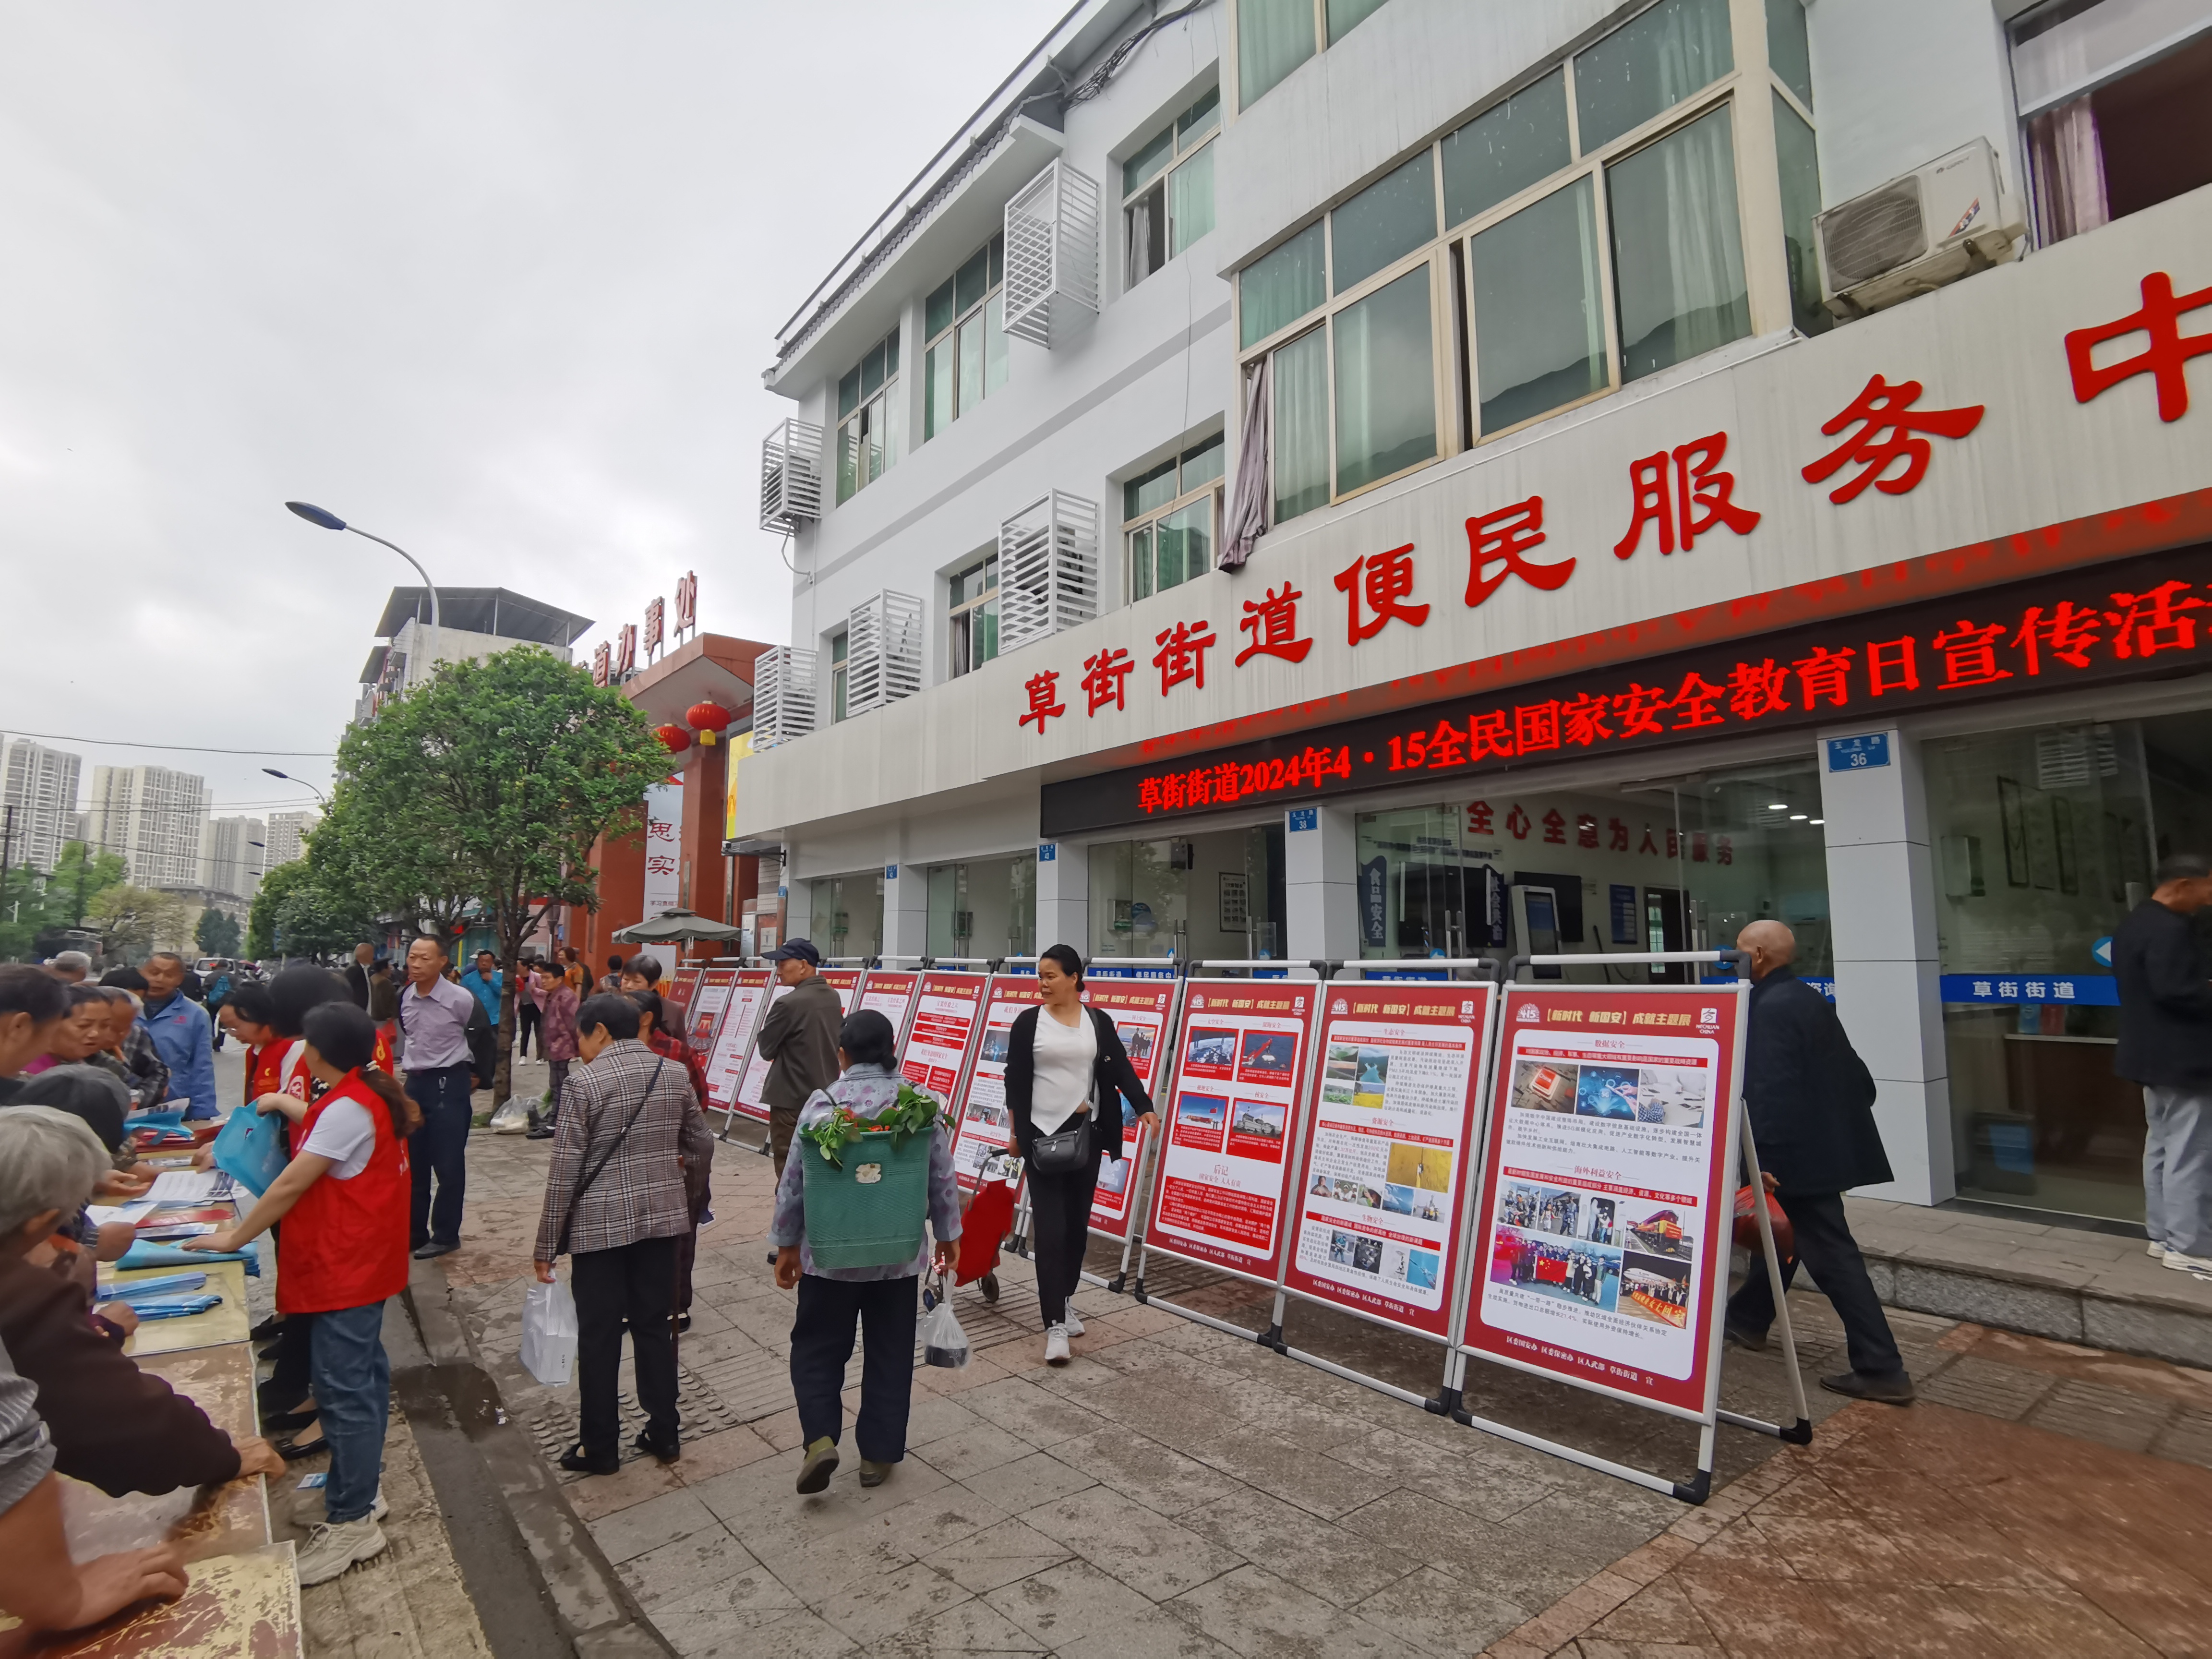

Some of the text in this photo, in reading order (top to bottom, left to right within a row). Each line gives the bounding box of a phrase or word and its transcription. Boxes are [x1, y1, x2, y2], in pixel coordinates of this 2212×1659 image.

[1019, 271, 2212, 734] 草街街道便民服务中
[578, 569, 697, 688] 道办事处
[1138, 580, 2212, 814] 草街街道2024年4·15全民国家安全教育日宣传活
[1851, 752, 1867, 767] 36
[648, 822, 681, 842] 思
[1298, 820, 1307, 830] 38
[1467, 800, 1732, 865] 全心全意为人民服务
[648, 855, 681, 875] 实
[1370, 867, 1383, 939] 食品安全
[1973, 981, 2075, 999] 草街街道
[1353, 1002, 1378, 1014] 【新时代
[1382, 1003, 1410, 1016] 新国安】
[1547, 1008, 1692, 1026] 【新时代 新国安】 成就主题展
[1383, 1028, 1406, 1036] 生态安全
[1595, 1039, 1625, 1049] 数据安全
[1372, 1117, 1394, 1127] 资源安全
[1213, 1164, 1229, 1176] 后记
[1575, 1165, 1622, 1180] 海外利益安全
[1361, 1214, 1384, 1226] 生物安全
[1577, 1357, 1605, 1371] 区人武部
[1610, 1365, 1638, 1382] 草街街道
[1645, 1376, 1654, 1386] 宣
